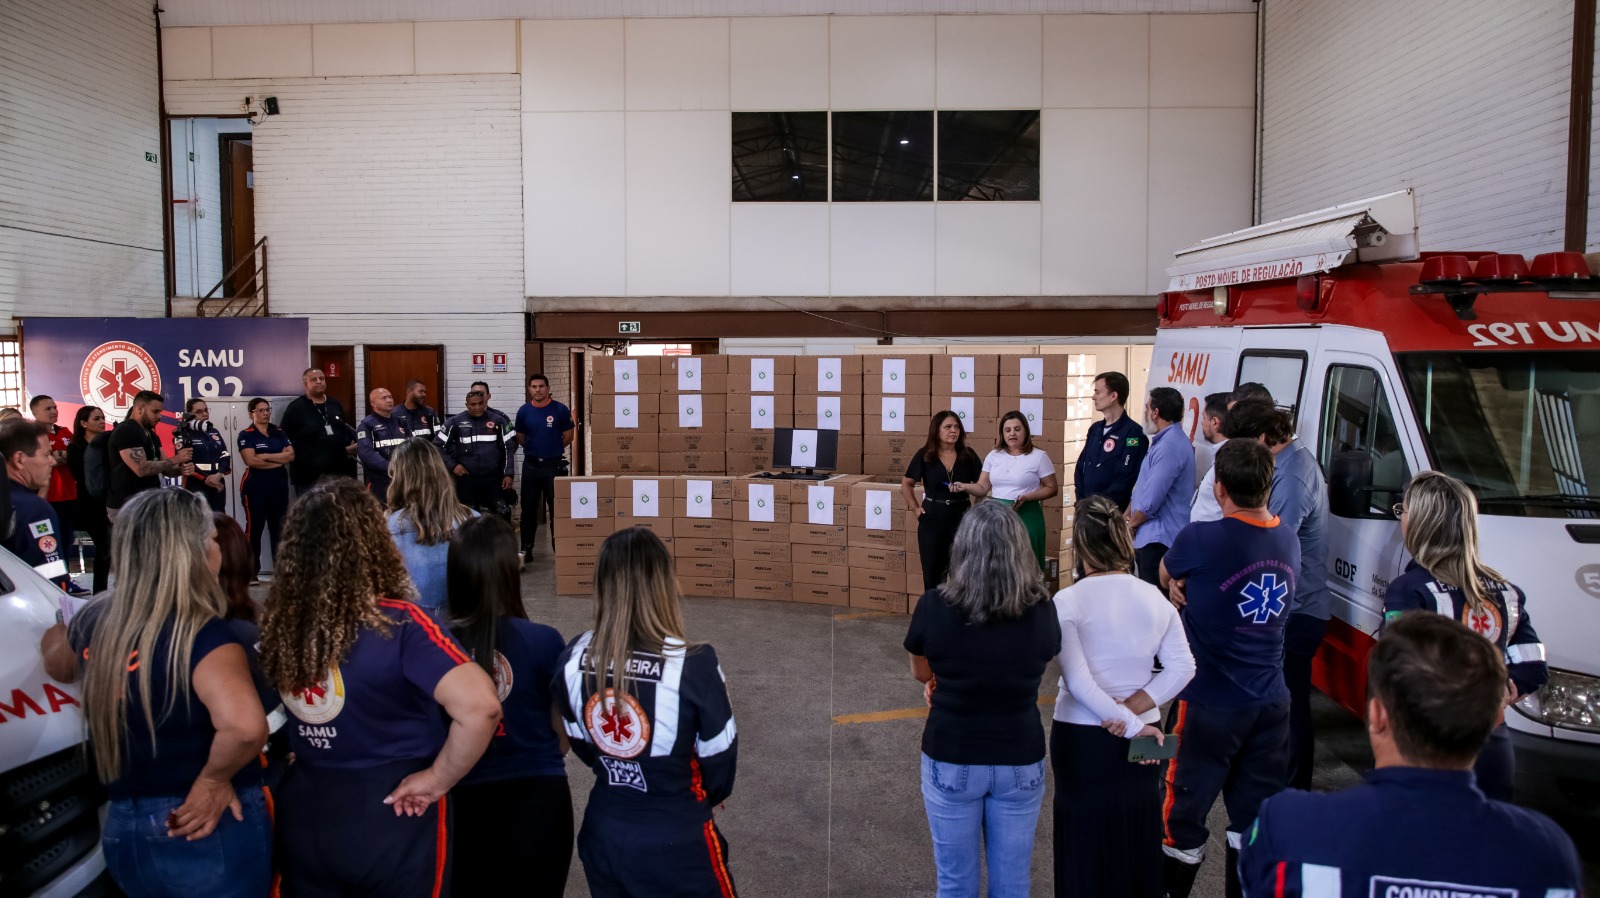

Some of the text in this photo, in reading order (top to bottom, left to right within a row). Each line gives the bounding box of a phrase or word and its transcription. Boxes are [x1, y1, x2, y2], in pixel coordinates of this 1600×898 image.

[1195, 273, 1217, 288] POSTO
[1241, 268, 1251, 283] DE
[178, 349, 244, 368] SAMU
[1168, 352, 1211, 386] SAMU
[1335, 557, 1357, 582] GDF
[298, 725, 337, 738] SAMU
[307, 737, 332, 749] 192
[610, 767, 644, 787] 192
